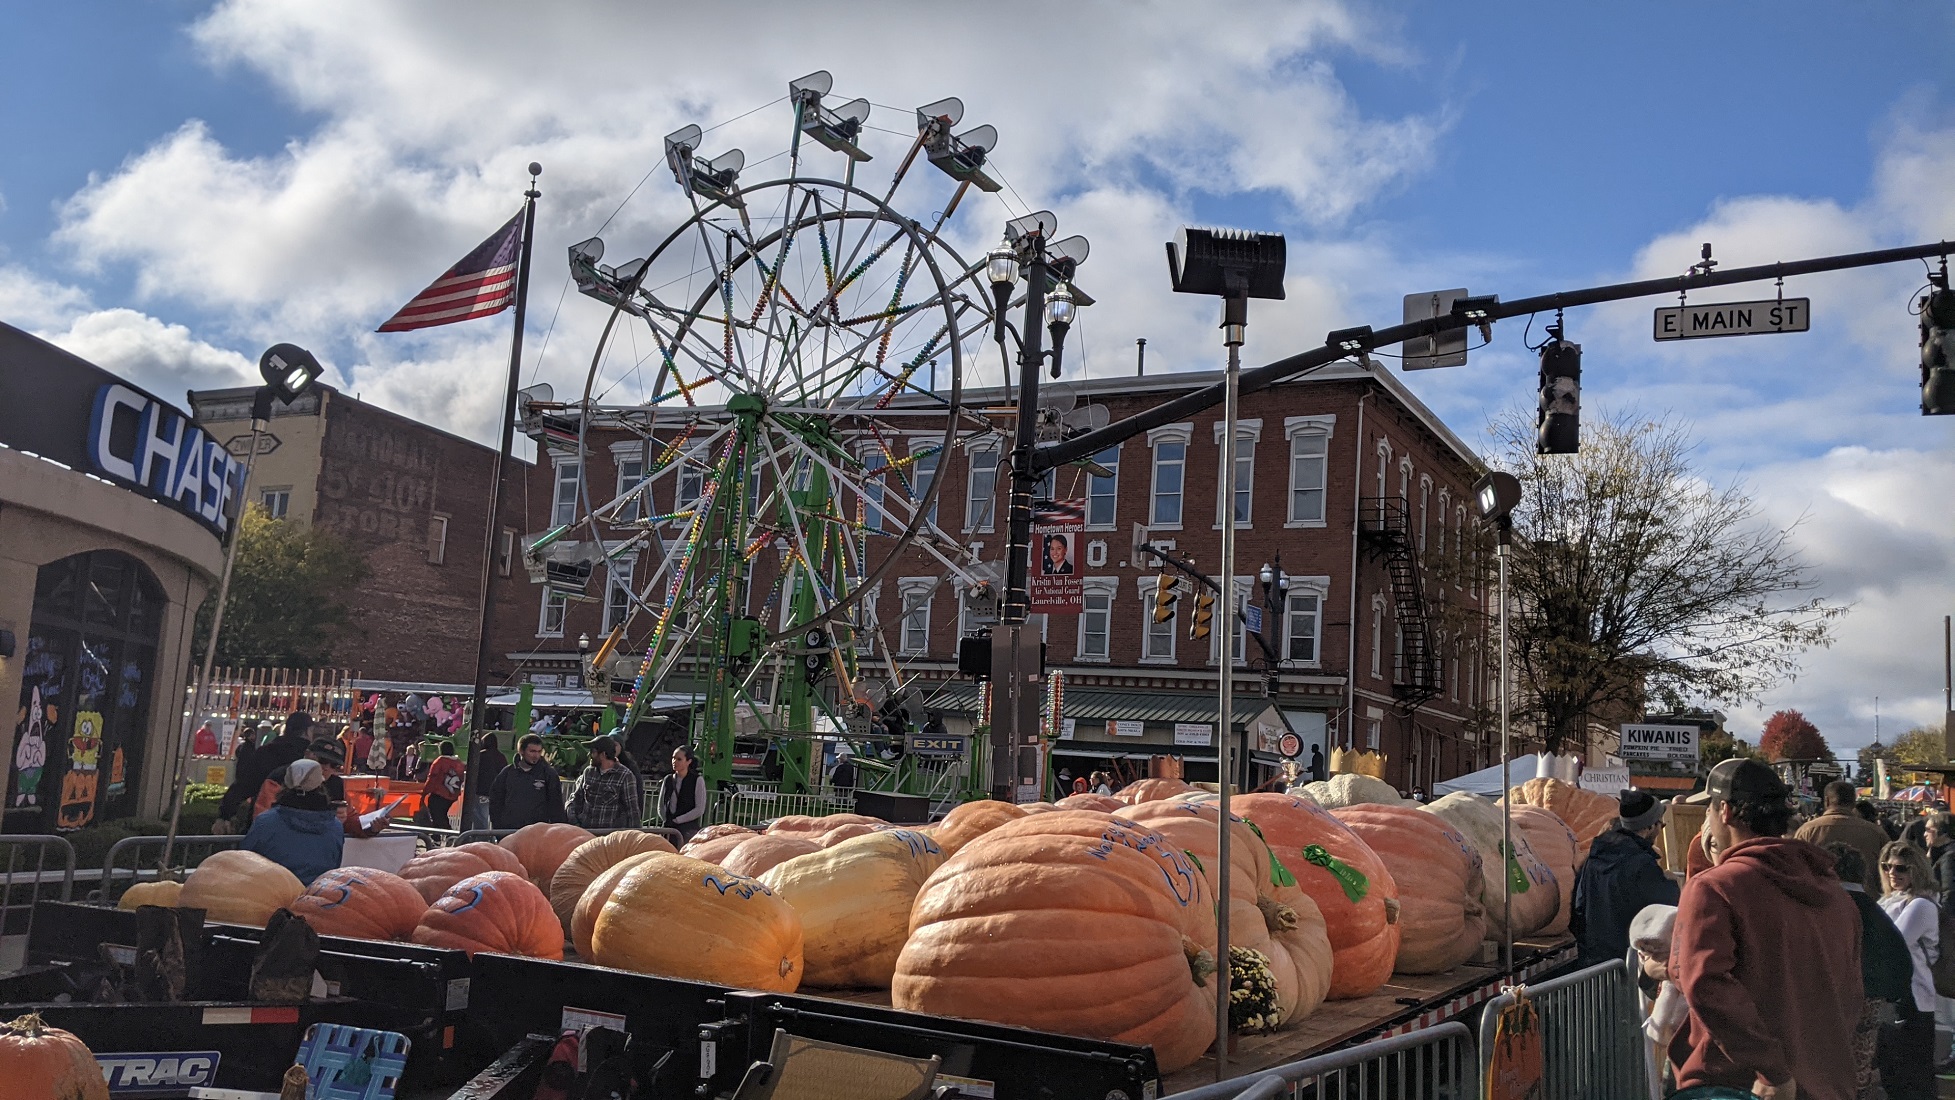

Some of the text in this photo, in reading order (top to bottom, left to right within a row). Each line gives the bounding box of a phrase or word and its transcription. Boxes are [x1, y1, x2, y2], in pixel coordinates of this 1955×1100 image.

[1663, 306, 1798, 333] E MAIN ST
[97, 383, 238, 532] CHASE
[1035, 522, 1084, 534] Hometown Heroes
[1031, 576, 1083, 586] Kristin Van Fossen
[1035, 586, 1080, 595] Air National Guard
[1031, 595, 1082, 606] Laurelville, OH
[1628, 729, 1691, 745] KIWANIS
[913, 739, 962, 749] EXIT
[1584, 772, 1628, 783] CHRISTIAN
